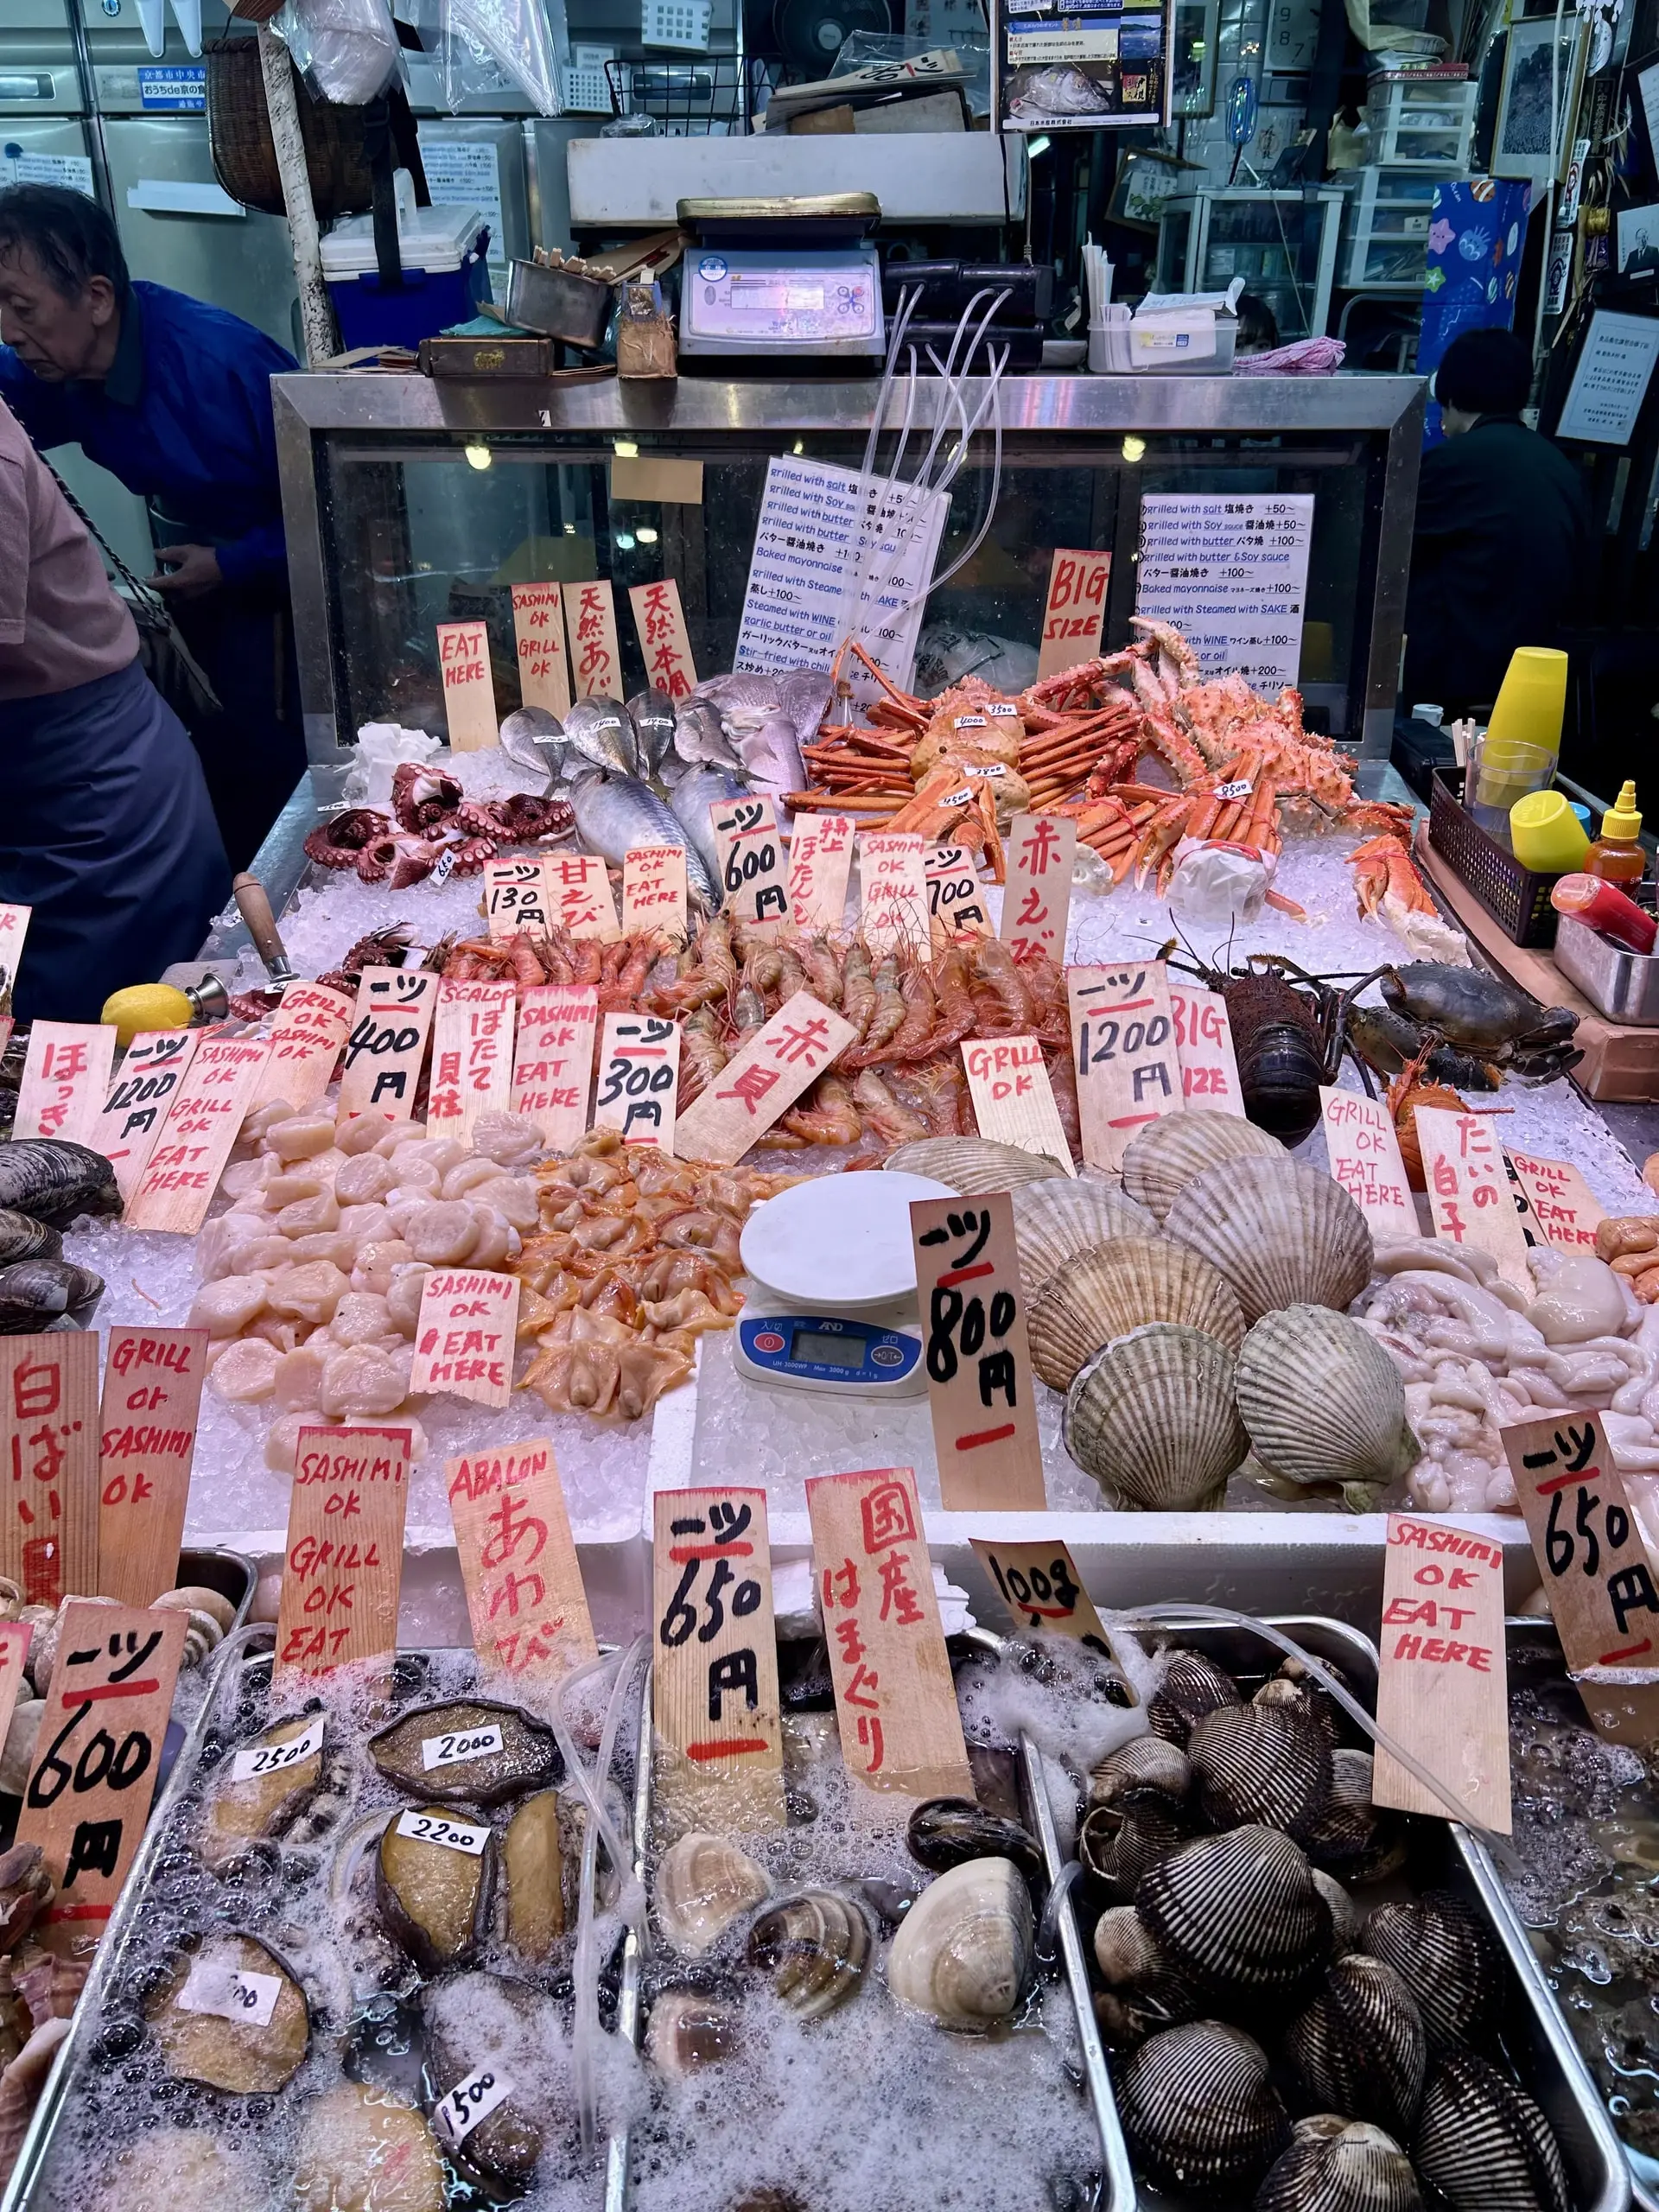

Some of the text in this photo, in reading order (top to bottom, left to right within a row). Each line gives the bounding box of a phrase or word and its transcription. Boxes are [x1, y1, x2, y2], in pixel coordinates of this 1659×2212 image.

[1280, 8, 1290, 22] 9
[1280, 31, 1290, 46] 8
[771, 468, 845, 491] grilled with salt
[770, 485, 843, 507] grilled with Soy
[767, 501, 854, 525] grilled with butter
[1147, 504, 1254, 515] grilled with salt 塩焼き
[762, 517, 849, 541] grilled with butter
[1148, 521, 1179, 531] grilled
[1181, 521, 1201, 530] with
[1205, 521, 1222, 530] Soy
[1147, 537, 1179, 547] grilled
[1181, 537, 1200, 546] with
[1203, 537, 1234, 546] butter
[756, 547, 842, 573] Baked mayonnaise
[1145, 553, 1175, 563] grilled
[1177, 553, 1198, 562] with
[1200, 553, 1230, 562] butter
[1049, 560, 1109, 611] BIG
[1144, 569, 1209, 578] バター醤油焼き
[753, 569, 898, 607] grilled with Steame AKE
[1142, 584, 1228, 594] Baked mayonnaise
[512, 594, 558, 610] SASHIMI
[747, 600, 836, 626] Steamed with WINE
[1141, 604, 1300, 615] grilled with Steamed with SAKE 酒
[745, 616, 771, 627] garlic
[774, 622, 804, 635] butter
[1044, 614, 1101, 639] SIZE
[442, 632, 482, 662] EAT
[518, 639, 559, 658] GRILL
[1204, 636, 1227, 645] WINE
[740, 645, 830, 671] Stir-fried with chili
[446, 661, 485, 688] HERE
[960, 716, 984, 726] 4000
[991, 705, 1013, 715] 3500
[594, 718, 617, 729] 1400
[944, 791, 969, 805] 4500
[1222, 783, 1247, 798] 8500
[626, 849, 683, 865] SASHIMI
[639, 861, 664, 872] OK
[726, 842, 776, 892] 600
[878, 860, 905, 873] OK
[491, 887, 538, 914] 130
[552, 858, 605, 927] 甘えび
[626, 879, 664, 896] EAT
[633, 891, 678, 909] HERE
[868, 881, 919, 905] GRILL
[926, 879, 975, 915] 700
[755, 885, 788, 920] 円
[517, 909, 545, 925] 円
[954, 905, 983, 929] 円
[281, 990, 346, 1020] GRILL
[441, 987, 514, 1011] SCALOP
[294, 1013, 332, 1028] OK
[520, 1004, 595, 1030] SASHIMI
[345, 1014, 420, 1069] 400
[539, 1028, 575, 1047] OK
[1079, 1015, 1172, 1075] 1200
[196, 1046, 264, 1065] SASHIMI
[277, 1046, 314, 1059] OK
[468, 1014, 502, 1090] ほたて
[969, 1046, 1044, 1076] GRILL
[203, 1068, 238, 1084] OK
[517, 1059, 569, 1085] EAT
[716, 1018, 829, 1115] 赤貝
[103, 1072, 176, 1114] 1200
[371, 1071, 407, 1103] 円
[429, 1052, 463, 1118] 貝柱
[598, 1058, 674, 1106] 300
[993, 1075, 1033, 1101] OK
[1132, 1062, 1172, 1103] 円
[1181, 1065, 1228, 1096] IZE
[170, 1098, 232, 1119] GRILL
[518, 1087, 580, 1114] HERE
[176, 1119, 212, 1133] OK
[622, 1101, 661, 1135] 円
[1326, 1097, 1387, 1132] GRILL
[1357, 1132, 1386, 1152] OK
[148, 1146, 210, 1169] EAT
[1336, 1158, 1378, 1182] EAT
[1456, 1116, 1498, 1208] たいの
[1515, 1156, 1571, 1182] GRILL
[141, 1170, 210, 1195] HERE
[1348, 1181, 1405, 1207] HERE
[1535, 1181, 1566, 1198] OK
[1433, 1154, 1467, 1243] 白子
[1535, 1198, 1578, 1224] EAT
[427, 1275, 512, 1300] SASHIMI
[449, 1300, 491, 1317] OK
[926, 1287, 1016, 1383] 800
[112, 1338, 191, 1376] GRILL
[430, 1359, 505, 1386] HERE
[978, 1350, 1016, 1408] 円
[99, 1426, 192, 1459] SASHIMI
[296, 1452, 403, 1485] SASHIMI
[449, 1451, 548, 1503] ABALON
[1546, 1486, 1629, 1577] 650
[290, 1535, 379, 1582] GRILL
[1387, 1522, 1503, 1569] SASHIMI
[1414, 1565, 1479, 1589] OK
[304, 1584, 354, 1615] OK
[660, 1558, 761, 1647] 650
[1382, 1599, 1476, 1630] EAT
[282, 1626, 350, 1662] EAT
[1393, 1634, 1492, 1672] HERE
[823, 1557, 884, 1772] はまぐり
[709, 1649, 759, 1721] 円
[27, 1700, 152, 1809] 600
[251, 1739, 310, 1773] 2500
[439, 1733, 495, 1760] 2000
[412, 1819, 474, 1847] 2200
[62, 1820, 123, 1889] 円
[442, 2073, 496, 2136] 1500
